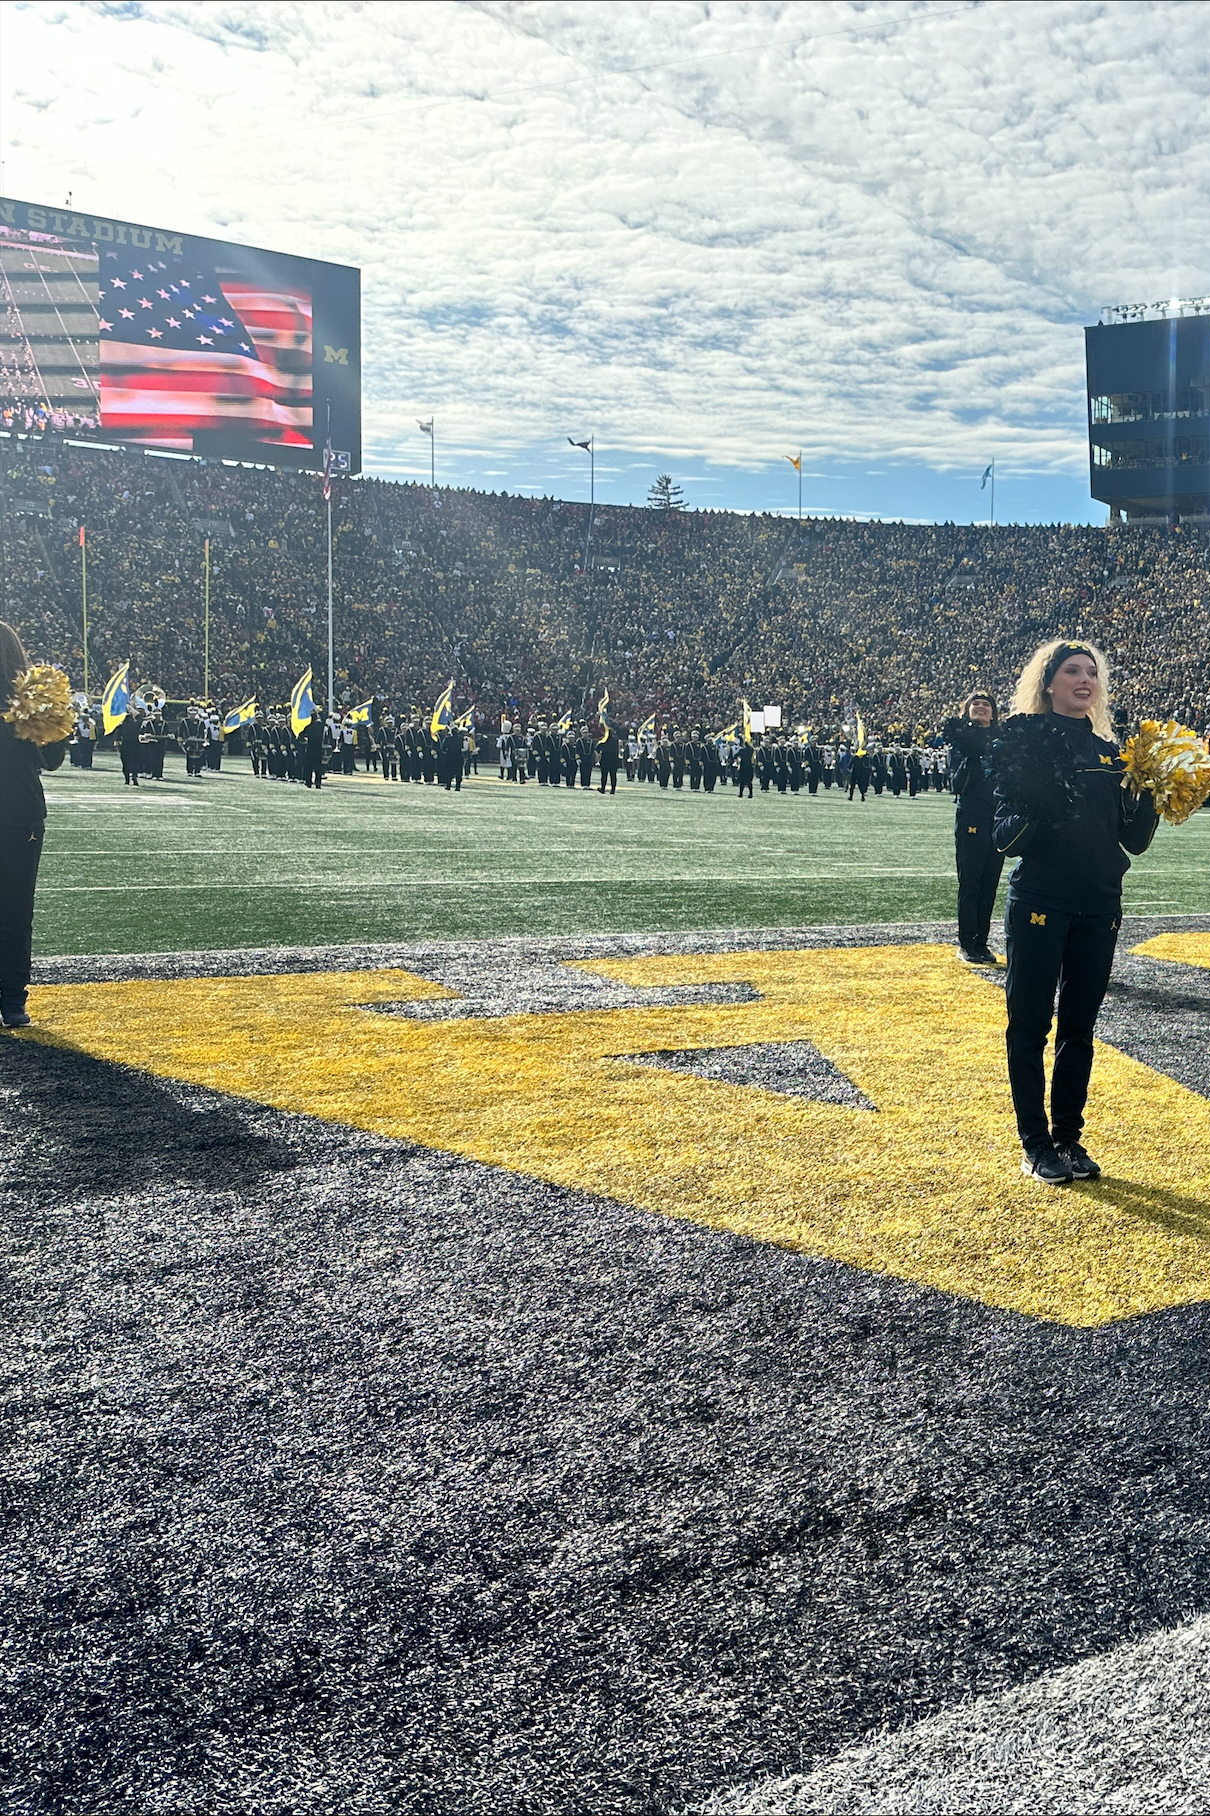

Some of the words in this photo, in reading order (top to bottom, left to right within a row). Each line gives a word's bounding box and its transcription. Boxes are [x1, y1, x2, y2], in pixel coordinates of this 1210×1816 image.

[28, 208, 183, 255] STADIUM
[324, 345, 348, 365] M
[350, 707, 369, 724] M
[1098, 754, 1112, 765] M
[1030, 912, 1047, 926] M
